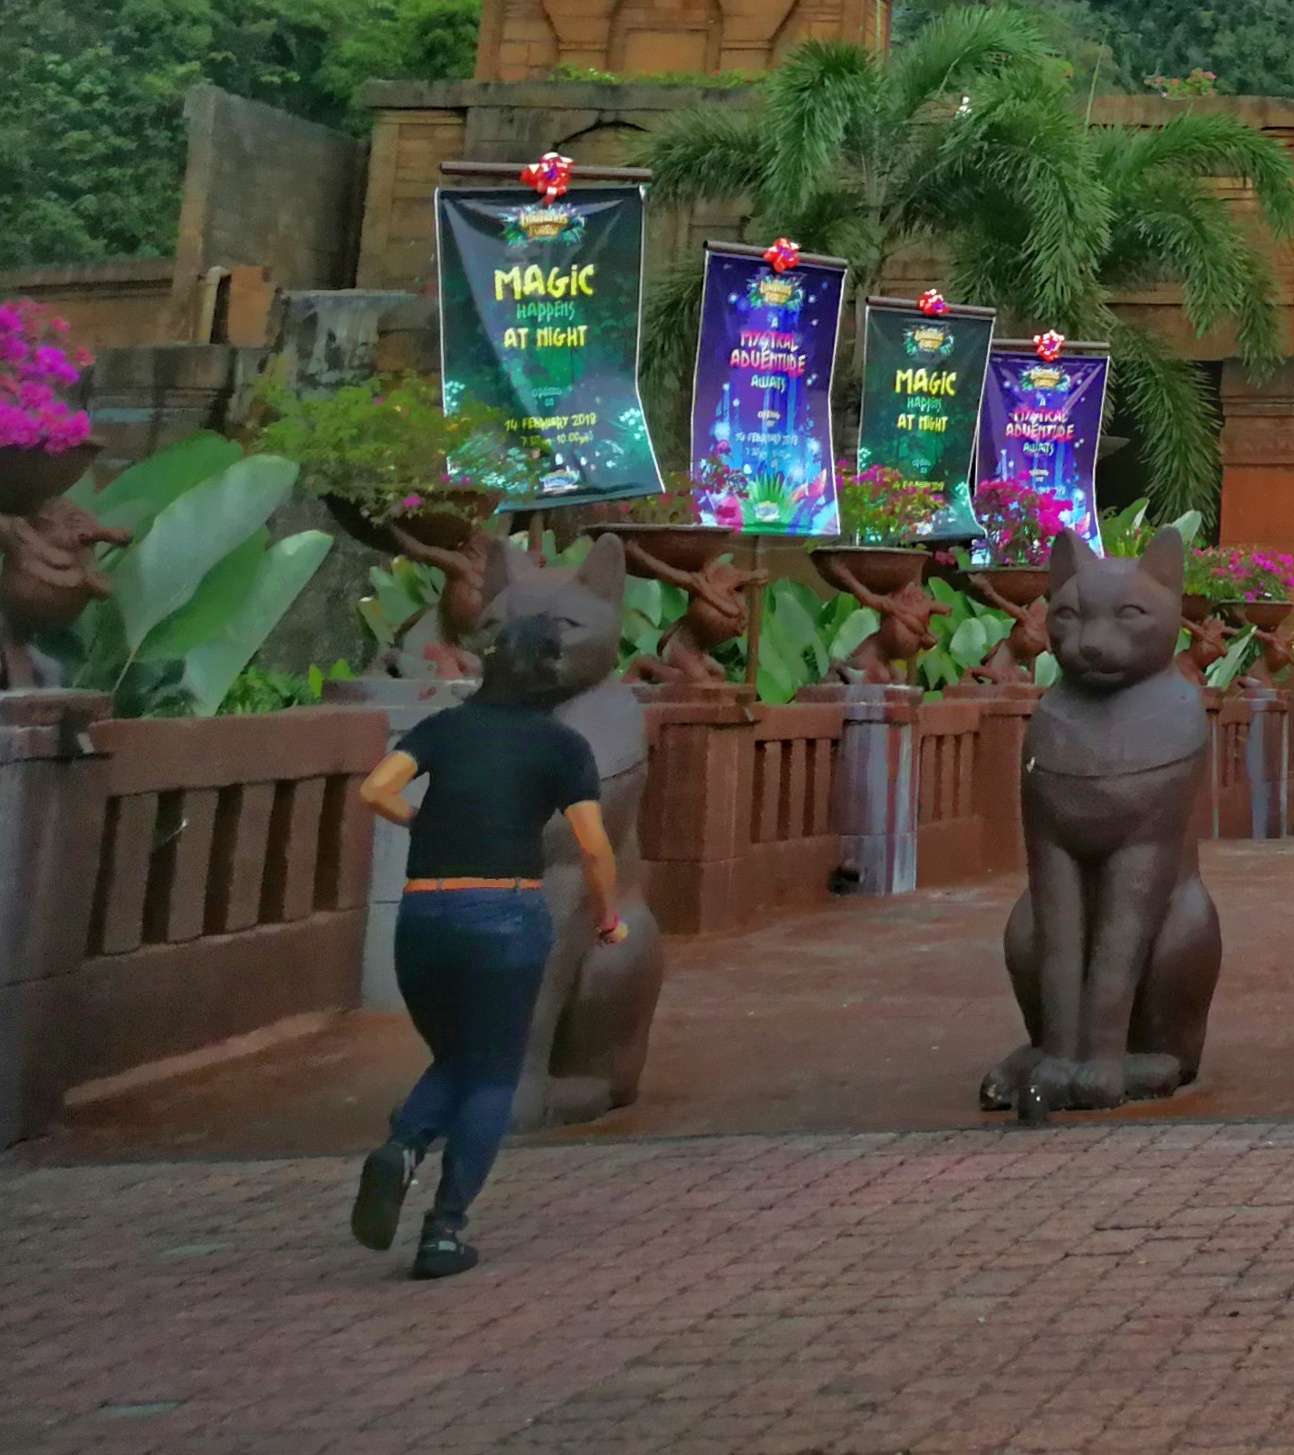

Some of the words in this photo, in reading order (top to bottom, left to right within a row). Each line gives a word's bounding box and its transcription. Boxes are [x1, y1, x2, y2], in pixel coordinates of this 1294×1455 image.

[504, 326, 529, 350] AT
[536, 325, 588, 348] NIGHT
[897, 413, 915, 431] AT
[918, 415, 949, 433] NIGHT
